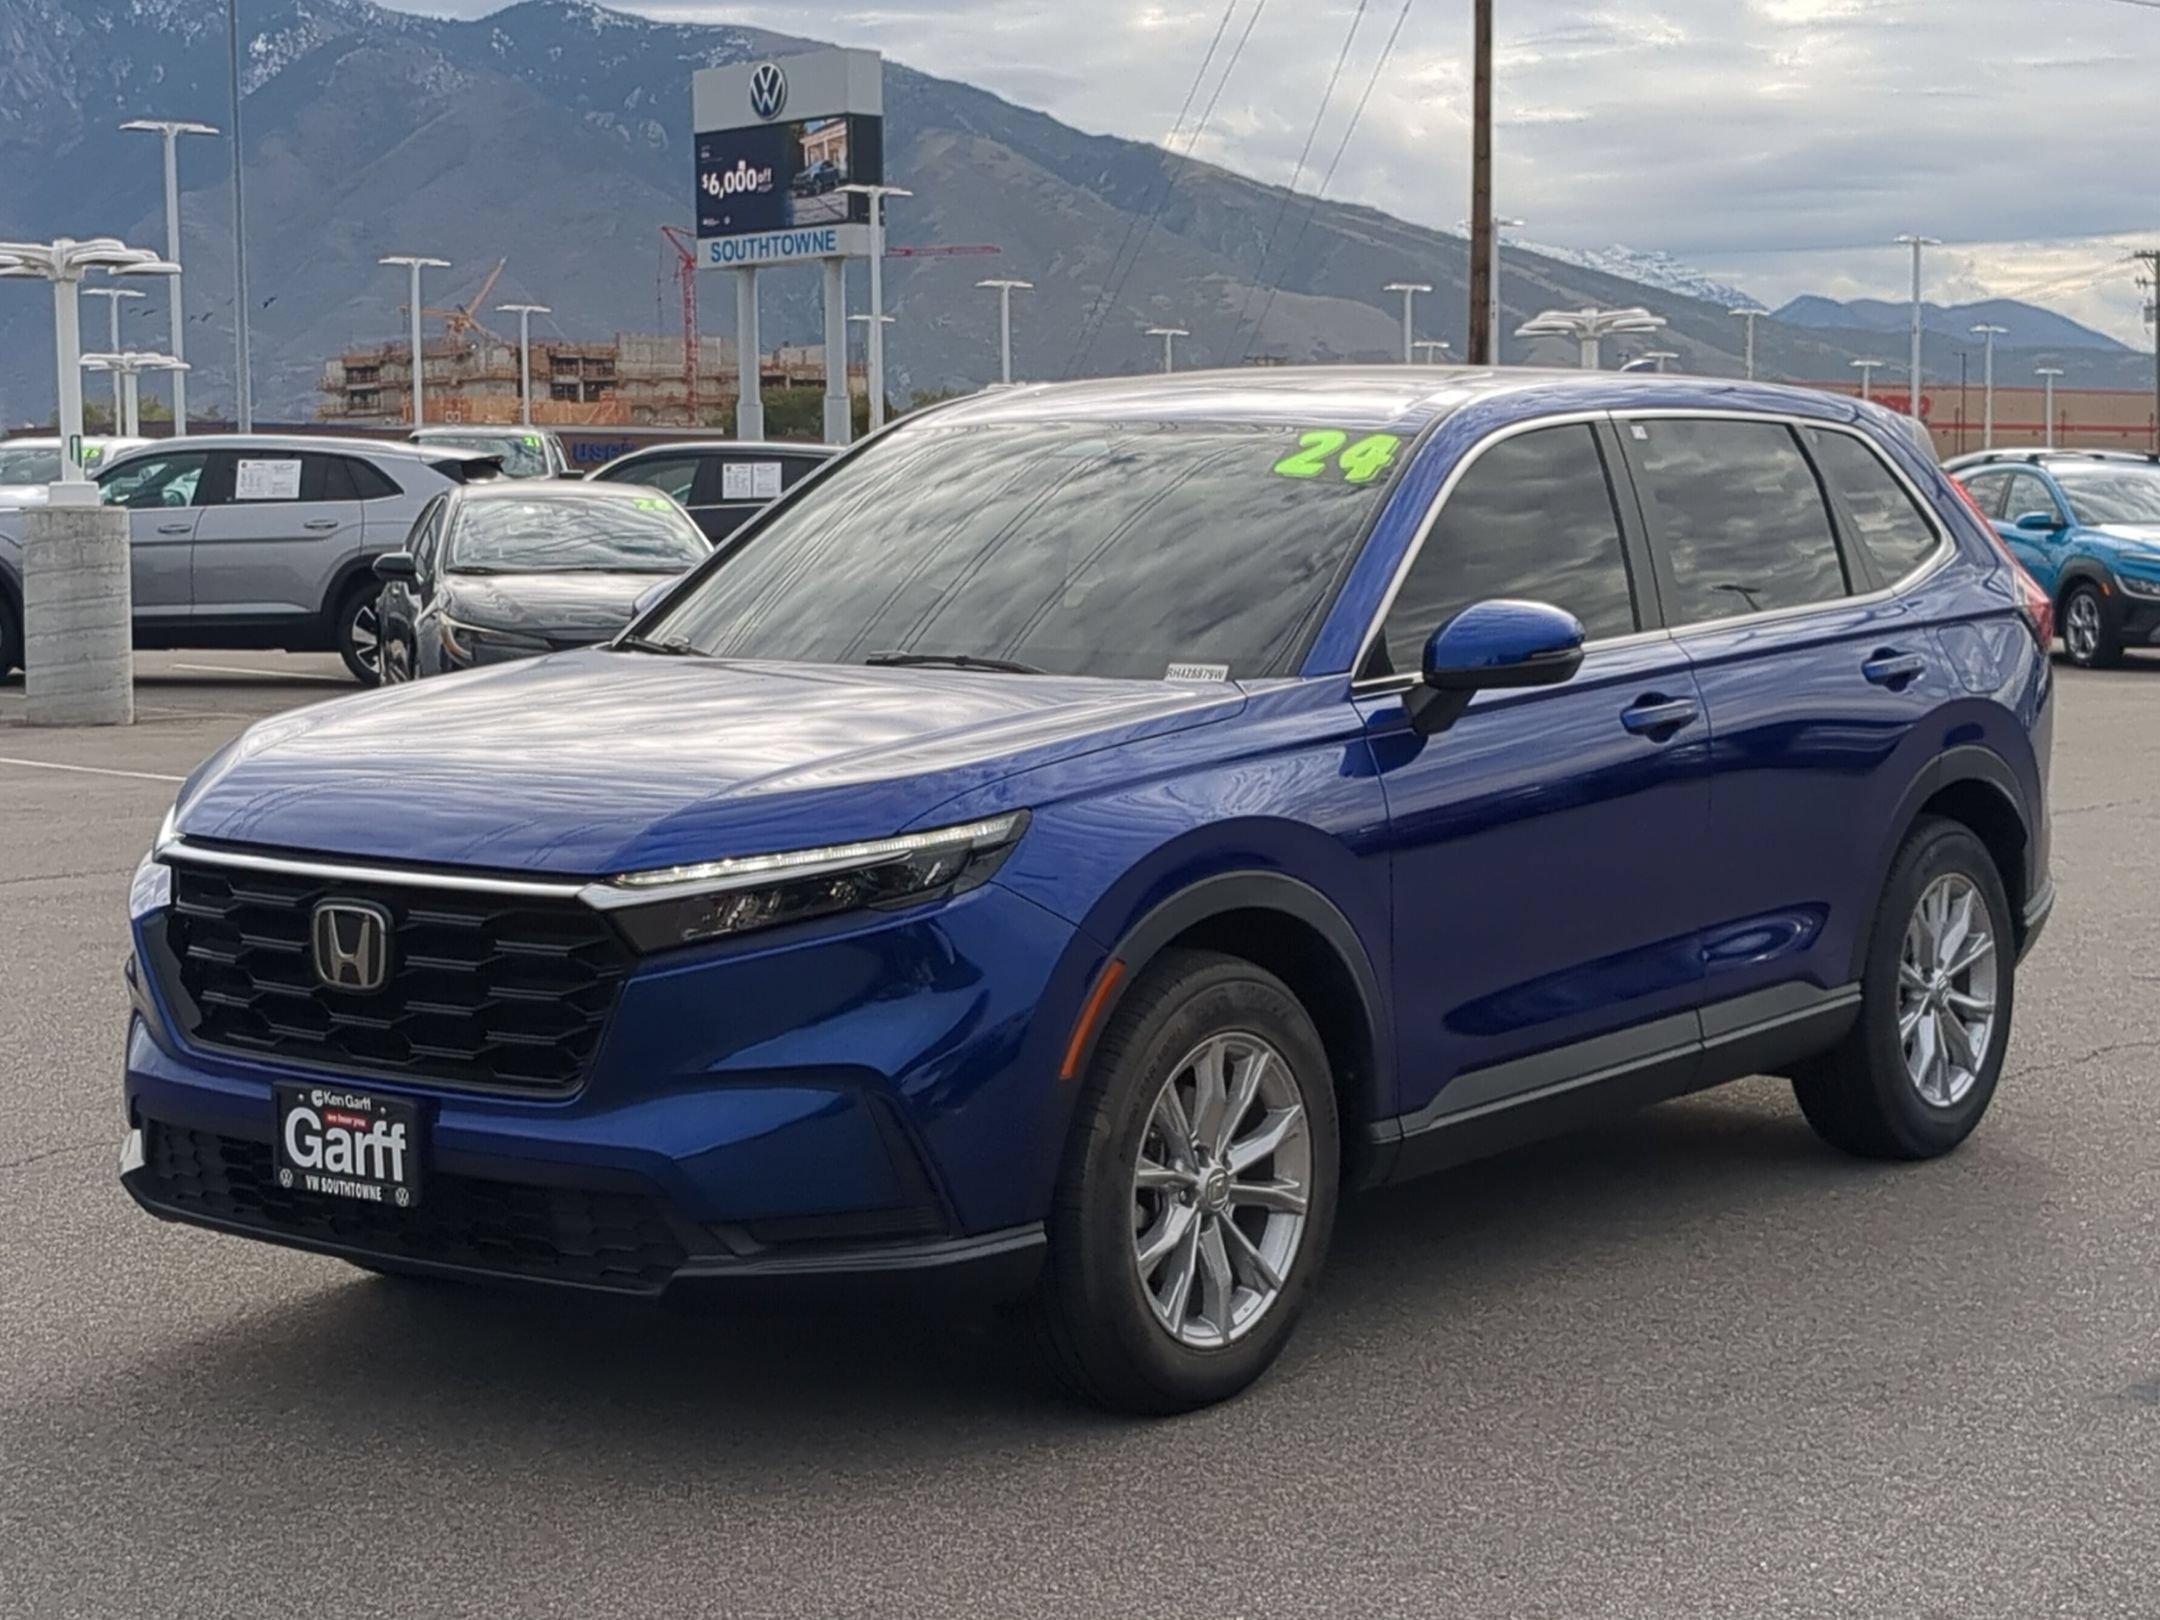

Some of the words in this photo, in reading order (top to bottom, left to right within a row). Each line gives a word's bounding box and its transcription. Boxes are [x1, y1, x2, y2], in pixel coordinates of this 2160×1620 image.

[702, 168, 757, 199] $6,000
[711, 230, 836, 263] SOUTHTOWNE
[1273, 429, 1402, 484] 24
[323, 1090, 344, 1106] Ken
[345, 1094, 371, 1111] Garff
[285, 1107, 406, 1182] Garff
[305, 1174, 319, 1191] VW
[320, 1177, 382, 1201] SOUTHTOWNE
